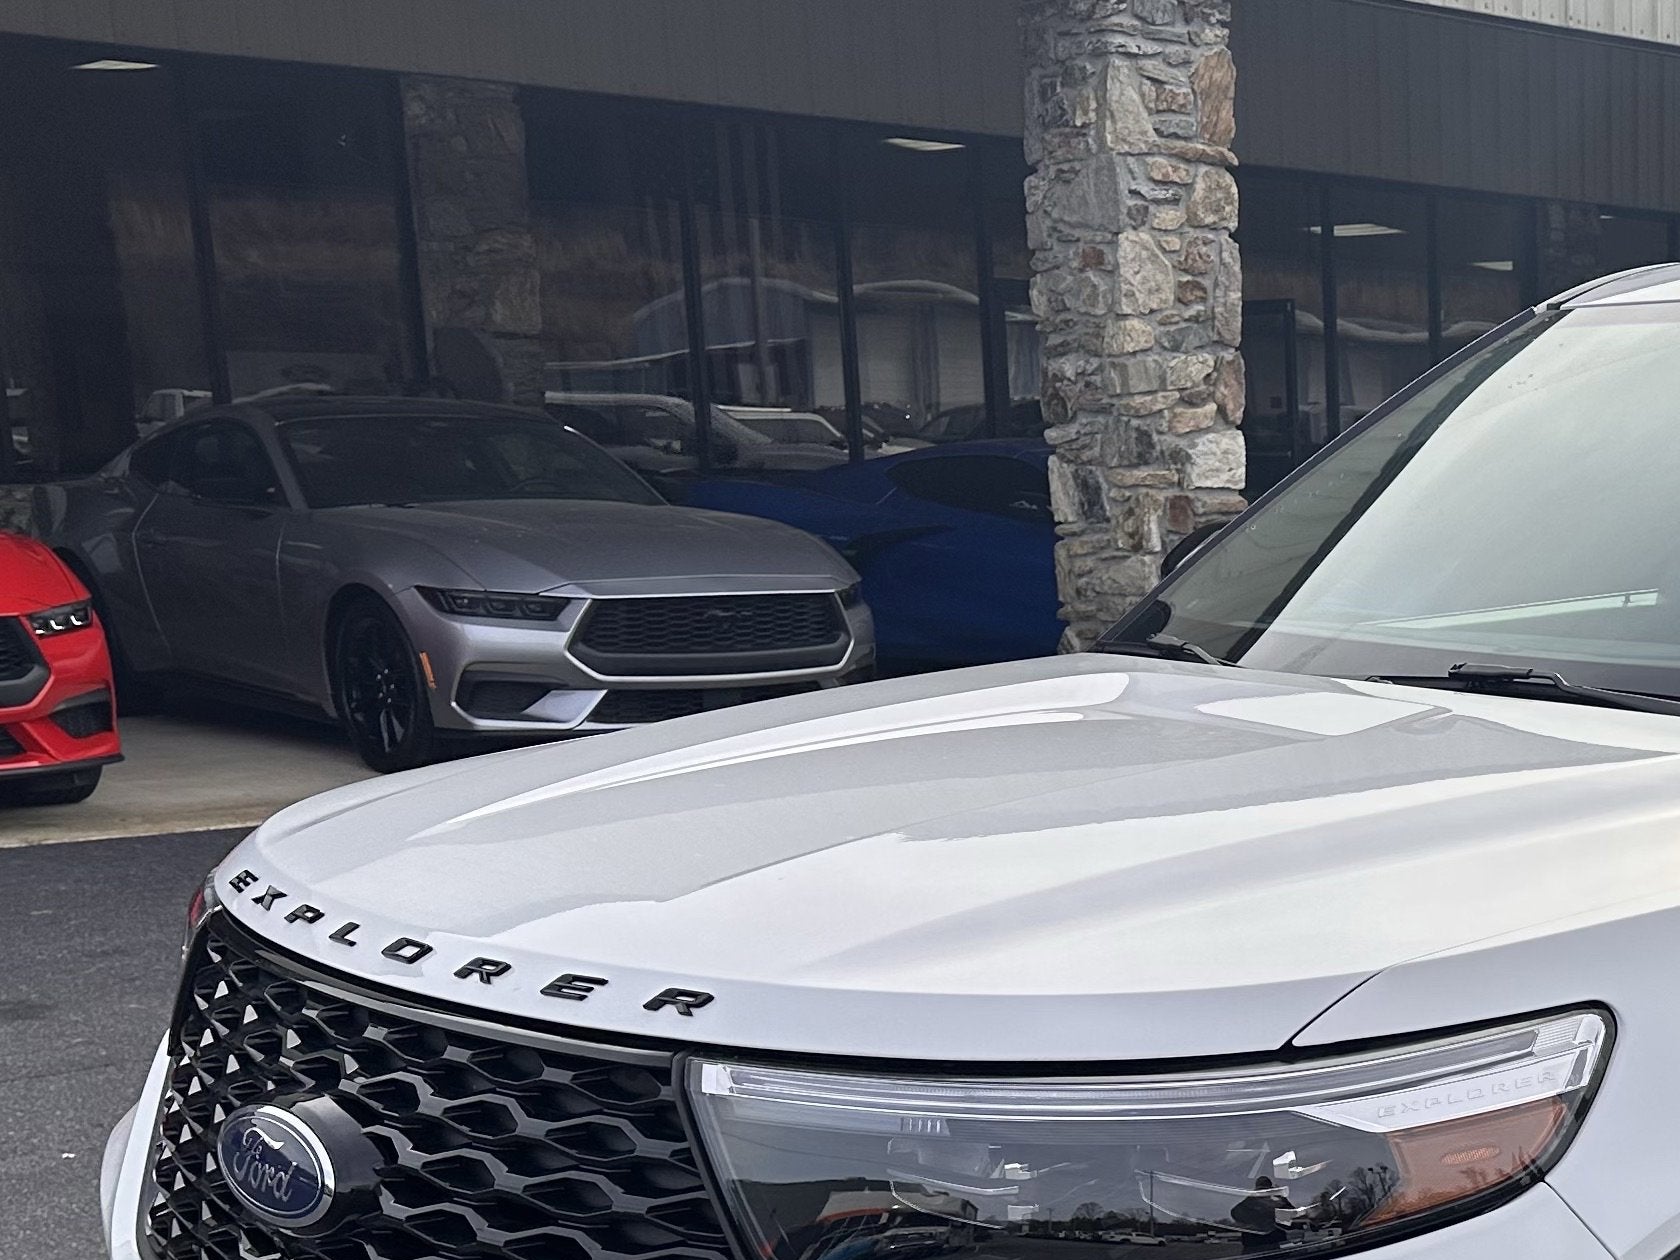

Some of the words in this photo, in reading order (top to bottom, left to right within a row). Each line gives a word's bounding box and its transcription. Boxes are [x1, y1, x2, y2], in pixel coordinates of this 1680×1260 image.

[229, 870, 715, 1017] EXPLORER
[1377, 1071, 1556, 1118] EXPLORER
[233, 1127, 298, 1202] Ford
